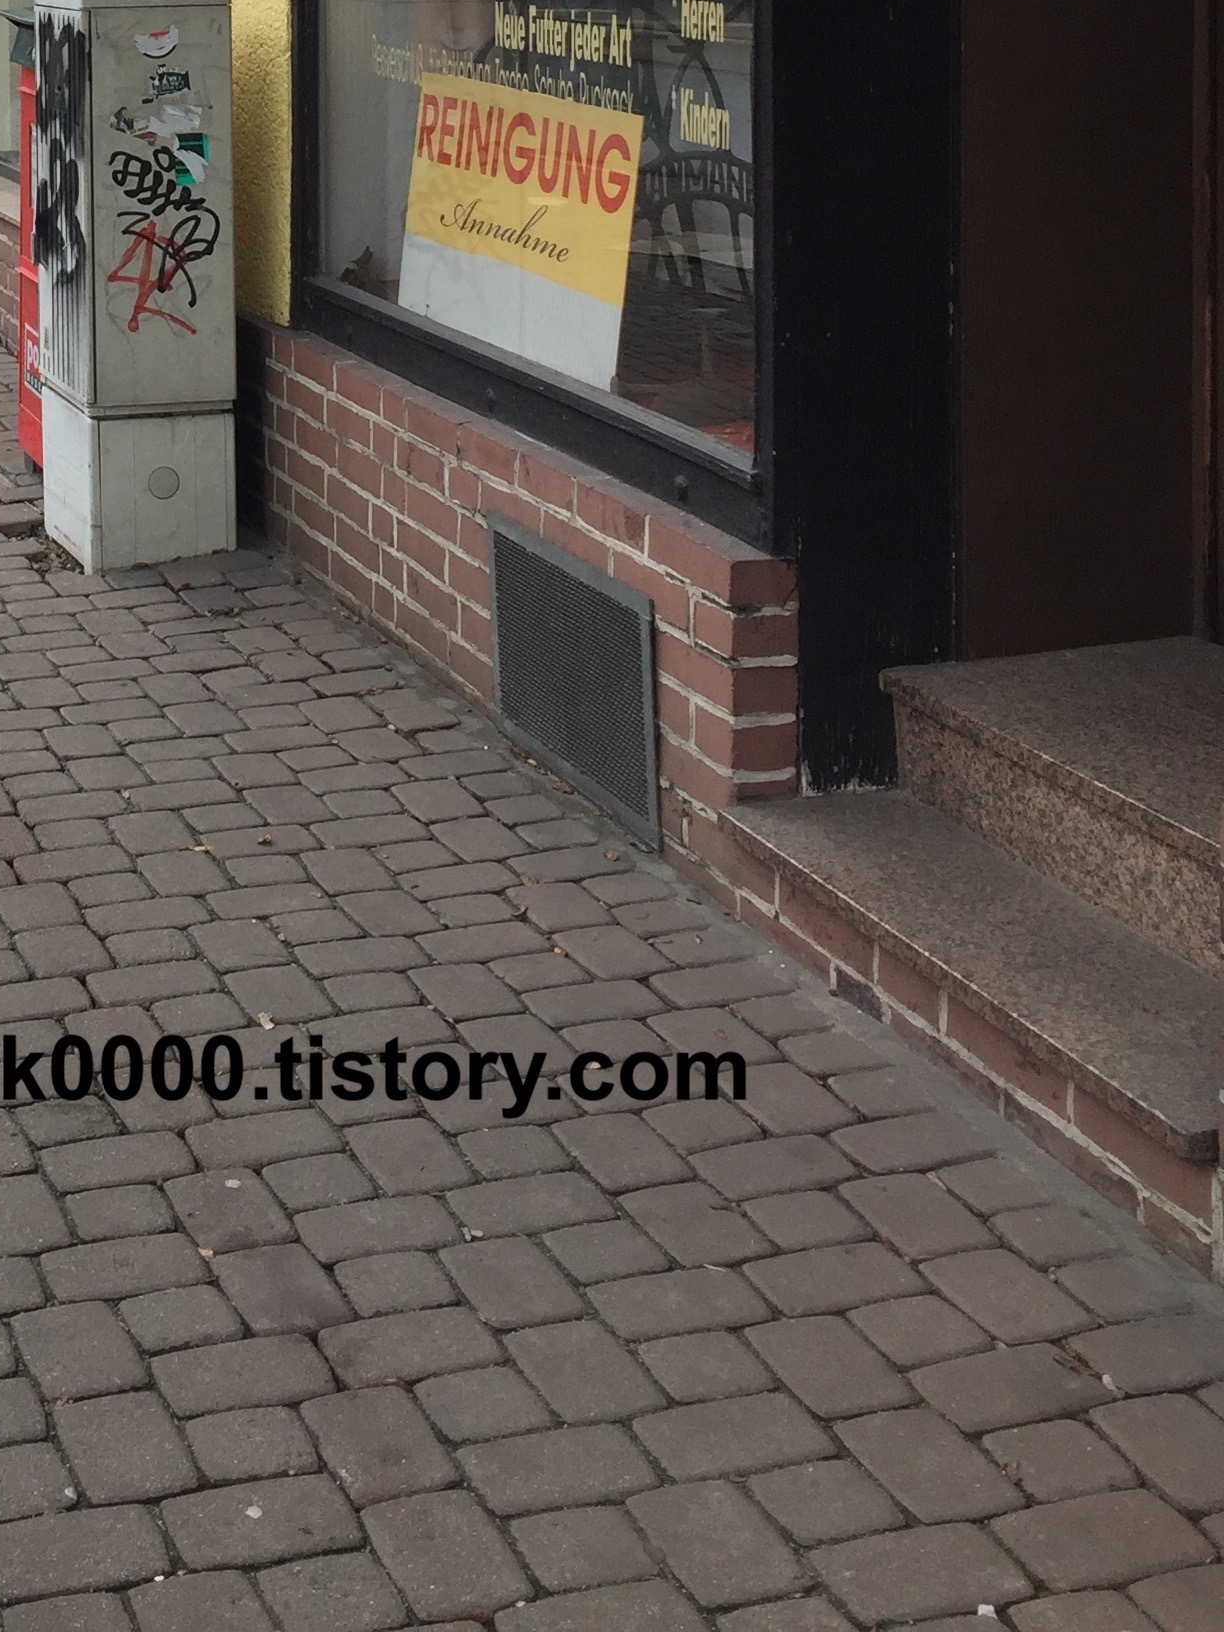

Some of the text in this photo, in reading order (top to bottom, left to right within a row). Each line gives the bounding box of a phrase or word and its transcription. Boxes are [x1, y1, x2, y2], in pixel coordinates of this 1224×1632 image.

[494, 0, 633, 71] Neue Futter jeder Art
[416, 92, 632, 214] REINIGUNG
[680, 87, 731, 151] Kindern
[439, 197, 570, 263] Annahme
